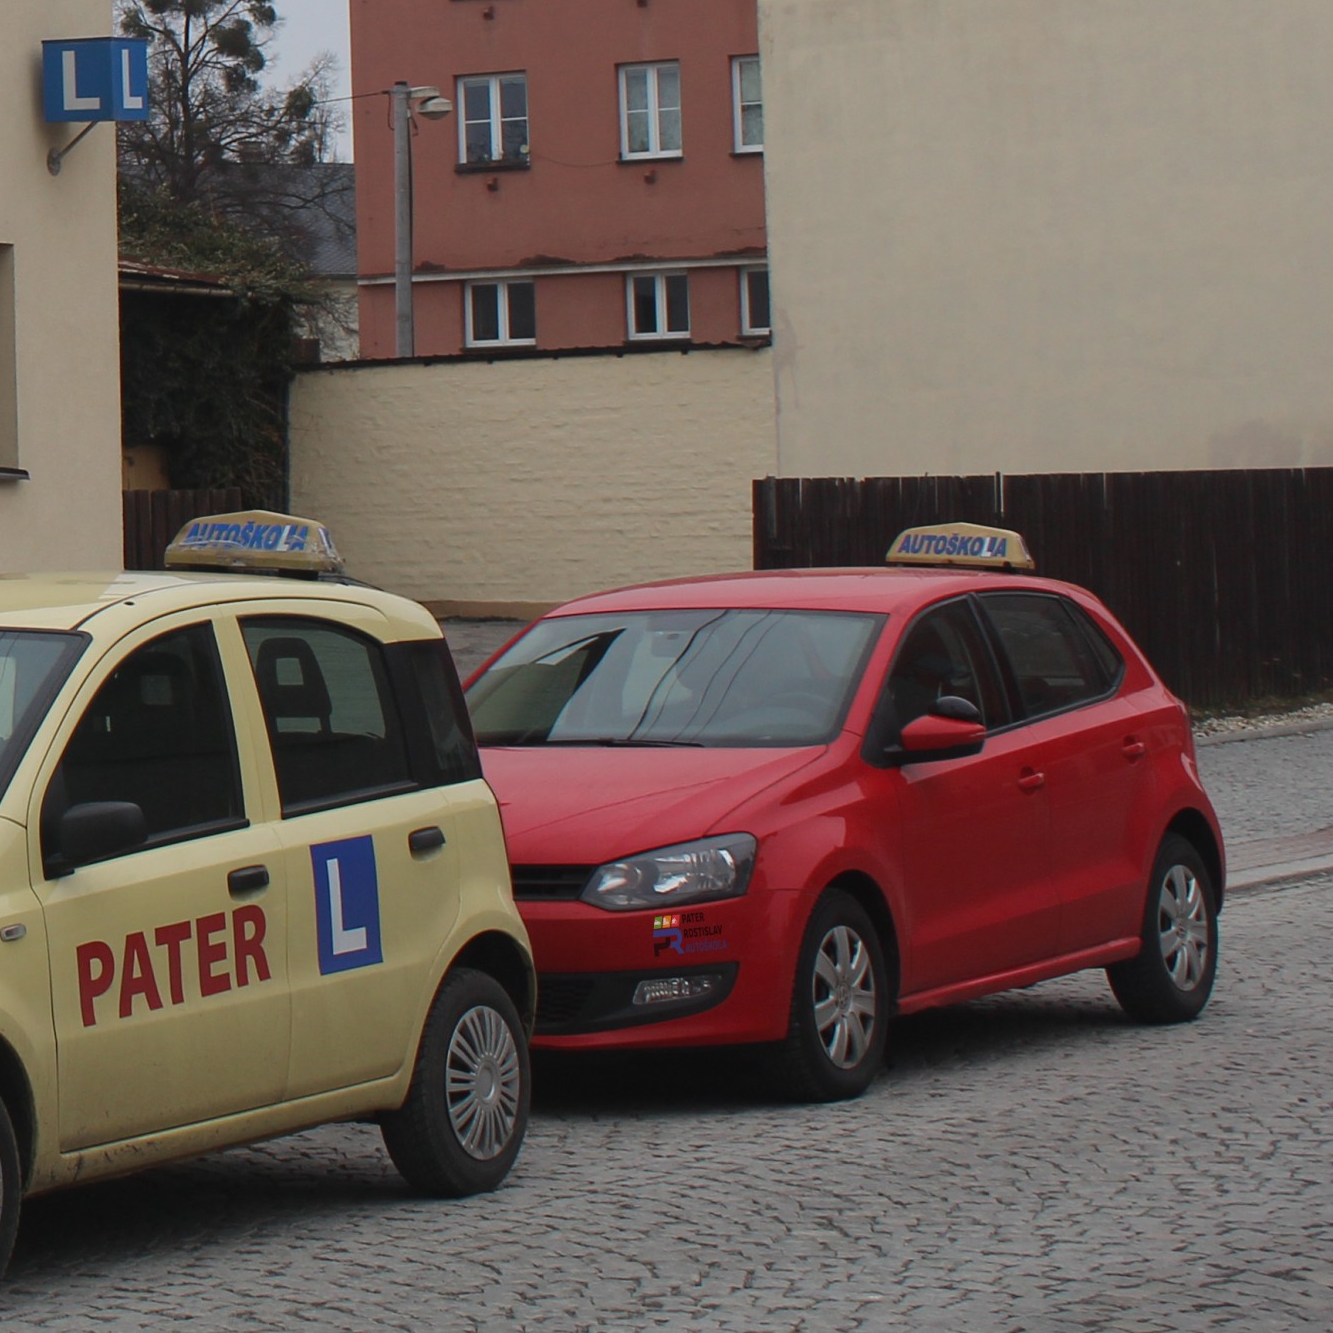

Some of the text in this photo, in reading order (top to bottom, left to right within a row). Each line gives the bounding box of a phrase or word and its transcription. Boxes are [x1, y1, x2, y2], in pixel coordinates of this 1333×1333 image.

[62, 50, 100, 110] L
[122, 49, 143, 109] L
[897, 533, 1007, 558] AUTOŠKOLA
[326, 858, 367, 955] L
[682, 912, 705, 924] PATER
[683, 925, 723, 939] ROSTISLAV
[76, 904, 271, 1027] PATER
